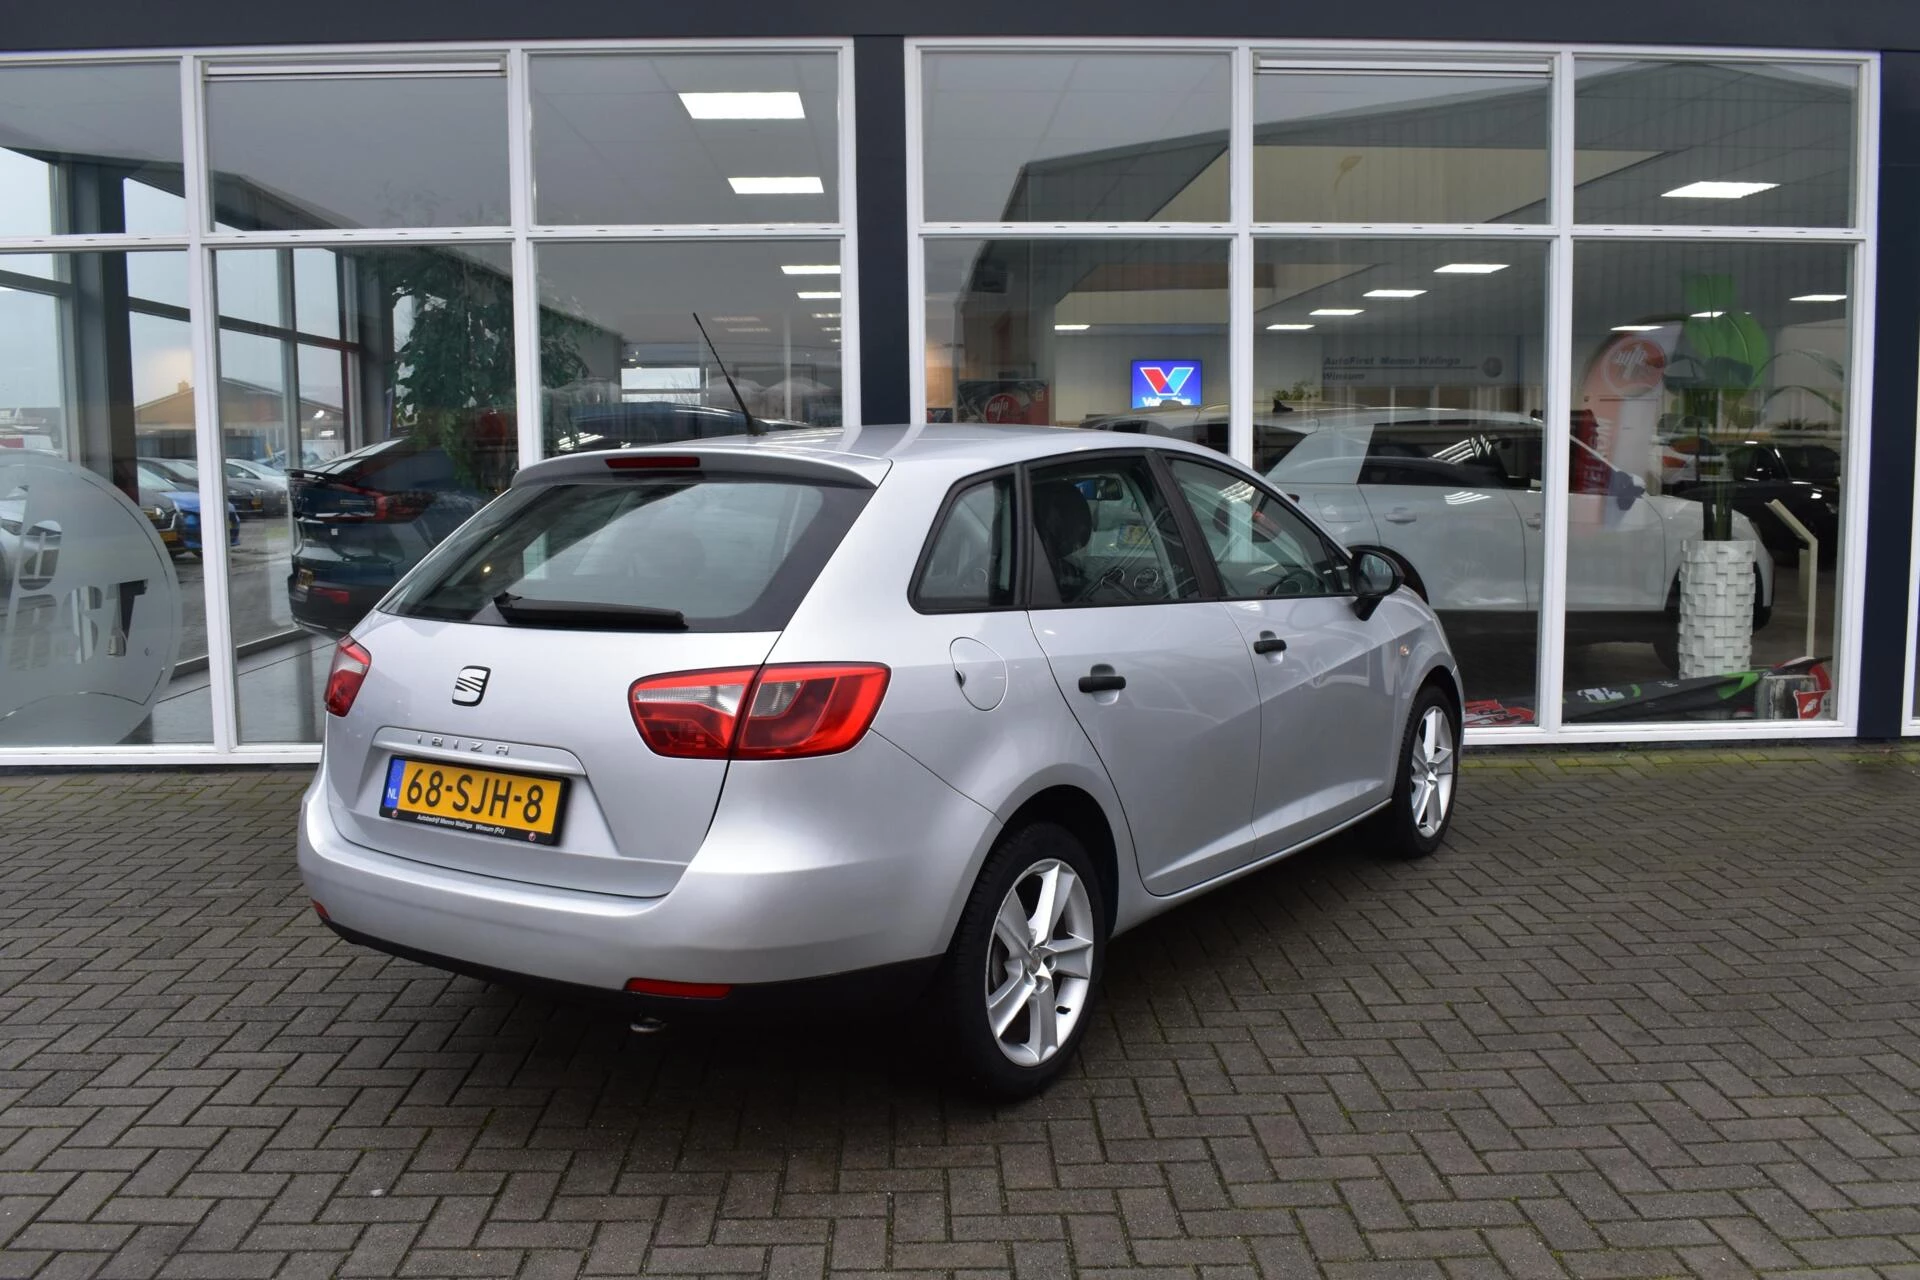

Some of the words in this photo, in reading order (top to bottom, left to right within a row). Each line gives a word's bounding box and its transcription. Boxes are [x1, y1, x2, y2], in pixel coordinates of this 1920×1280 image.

[416, 734, 510, 756] IBIZA
[386, 786, 398, 800] NL
[406, 768, 544, 824] 68-SJH-8
